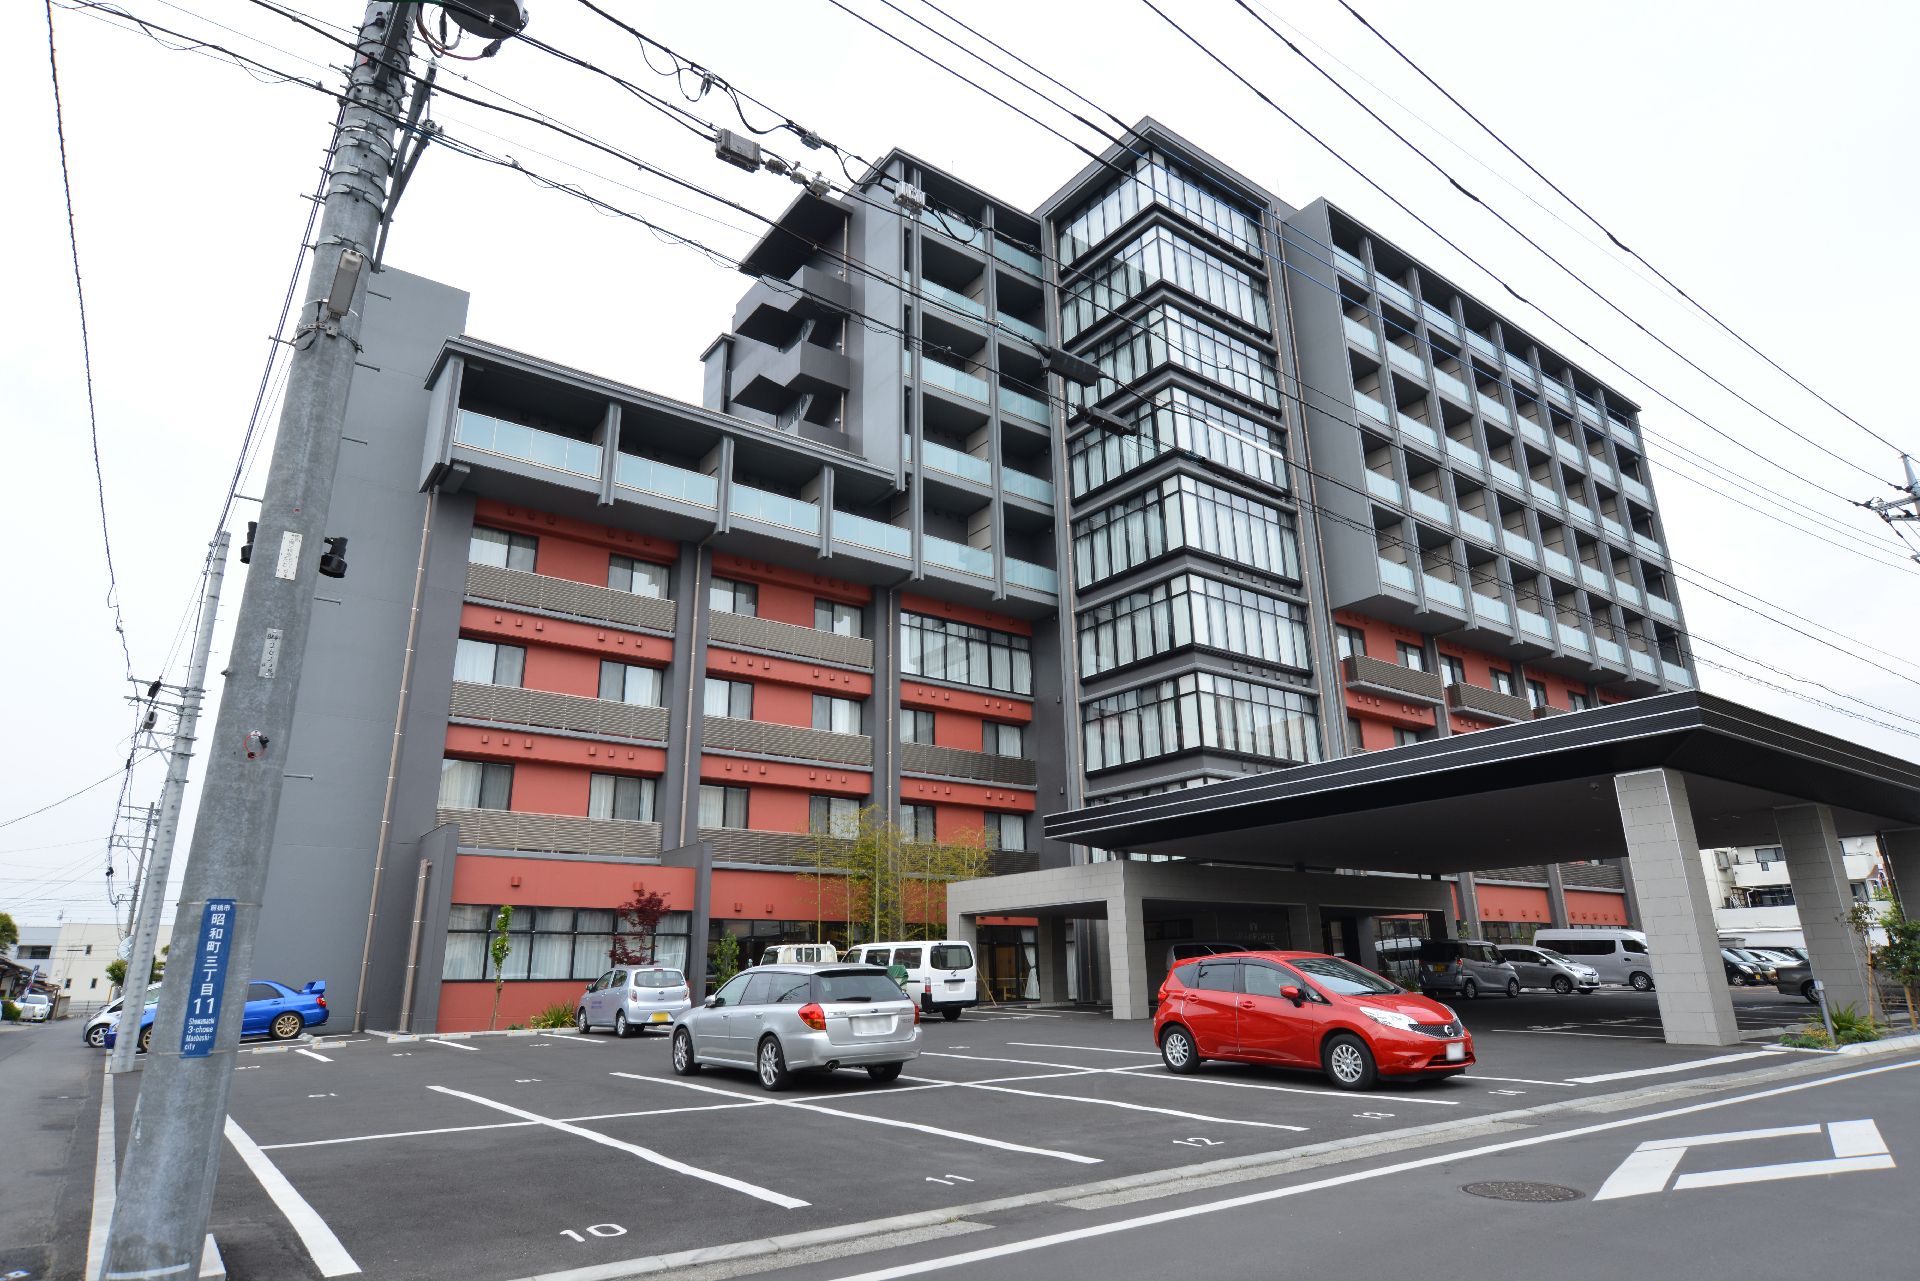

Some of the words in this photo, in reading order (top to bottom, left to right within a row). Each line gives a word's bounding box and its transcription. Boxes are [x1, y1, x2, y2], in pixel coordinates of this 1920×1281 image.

[193, 998, 214, 1014] 11
[1172, 1136, 1225, 1148] 12
[925, 1174, 975, 1186] 11
[559, 1223, 628, 1243] 10
